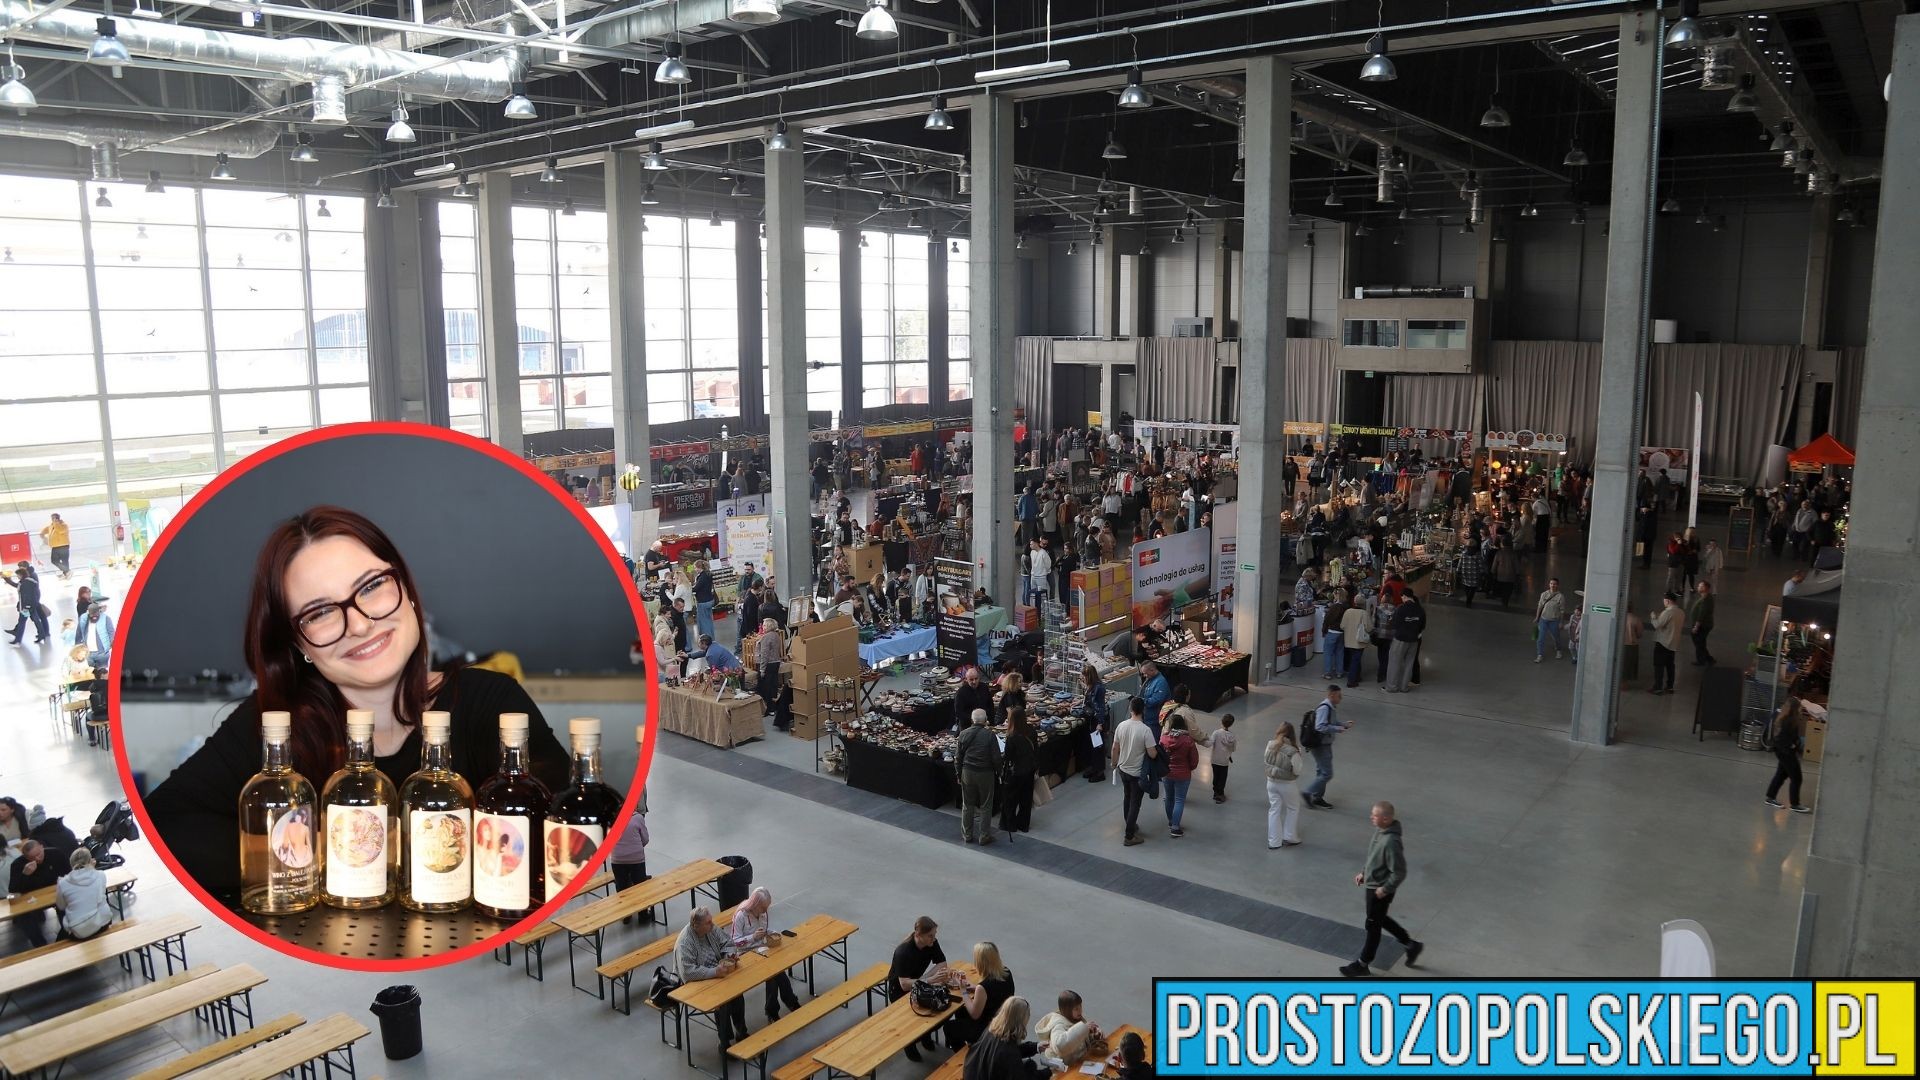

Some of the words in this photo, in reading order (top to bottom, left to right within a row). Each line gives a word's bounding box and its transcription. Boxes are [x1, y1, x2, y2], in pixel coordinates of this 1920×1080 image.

[1141, 551, 1159, 561] mBank
[1139, 569, 1178, 588] technologia
[1178, 567, 1187, 577] do
[1188, 563, 1205, 573] usług
